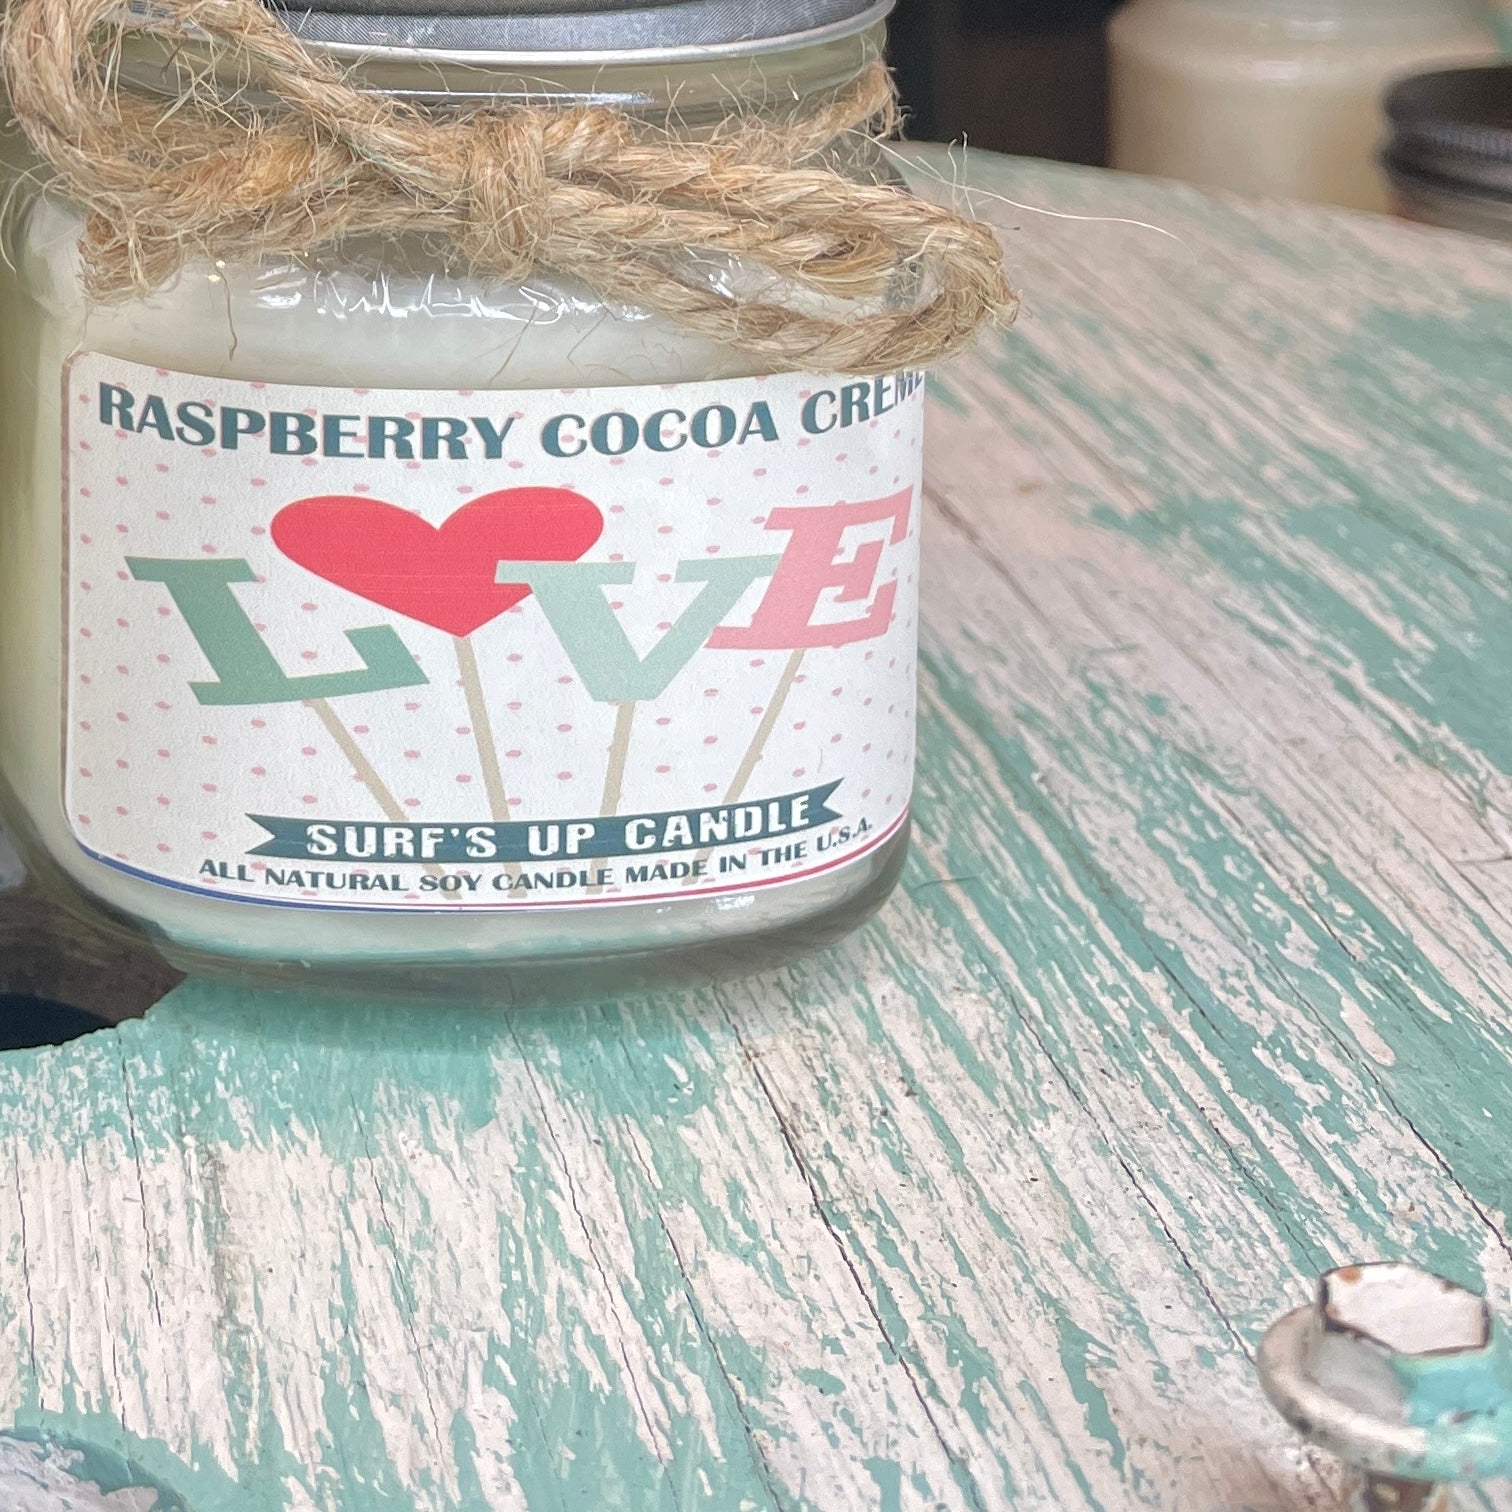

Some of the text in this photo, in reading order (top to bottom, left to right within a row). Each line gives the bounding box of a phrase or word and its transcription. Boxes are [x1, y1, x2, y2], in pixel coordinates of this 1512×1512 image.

[99, 381, 518, 460] RASPBERRY
[541, 401, 779, 458] COCOA
[198, 817, 873, 892] ALL NATURAL SOY CANDLE MADE IN THE U.S.A.
[306, 794, 811, 859] SURF'S UP CANDLE
